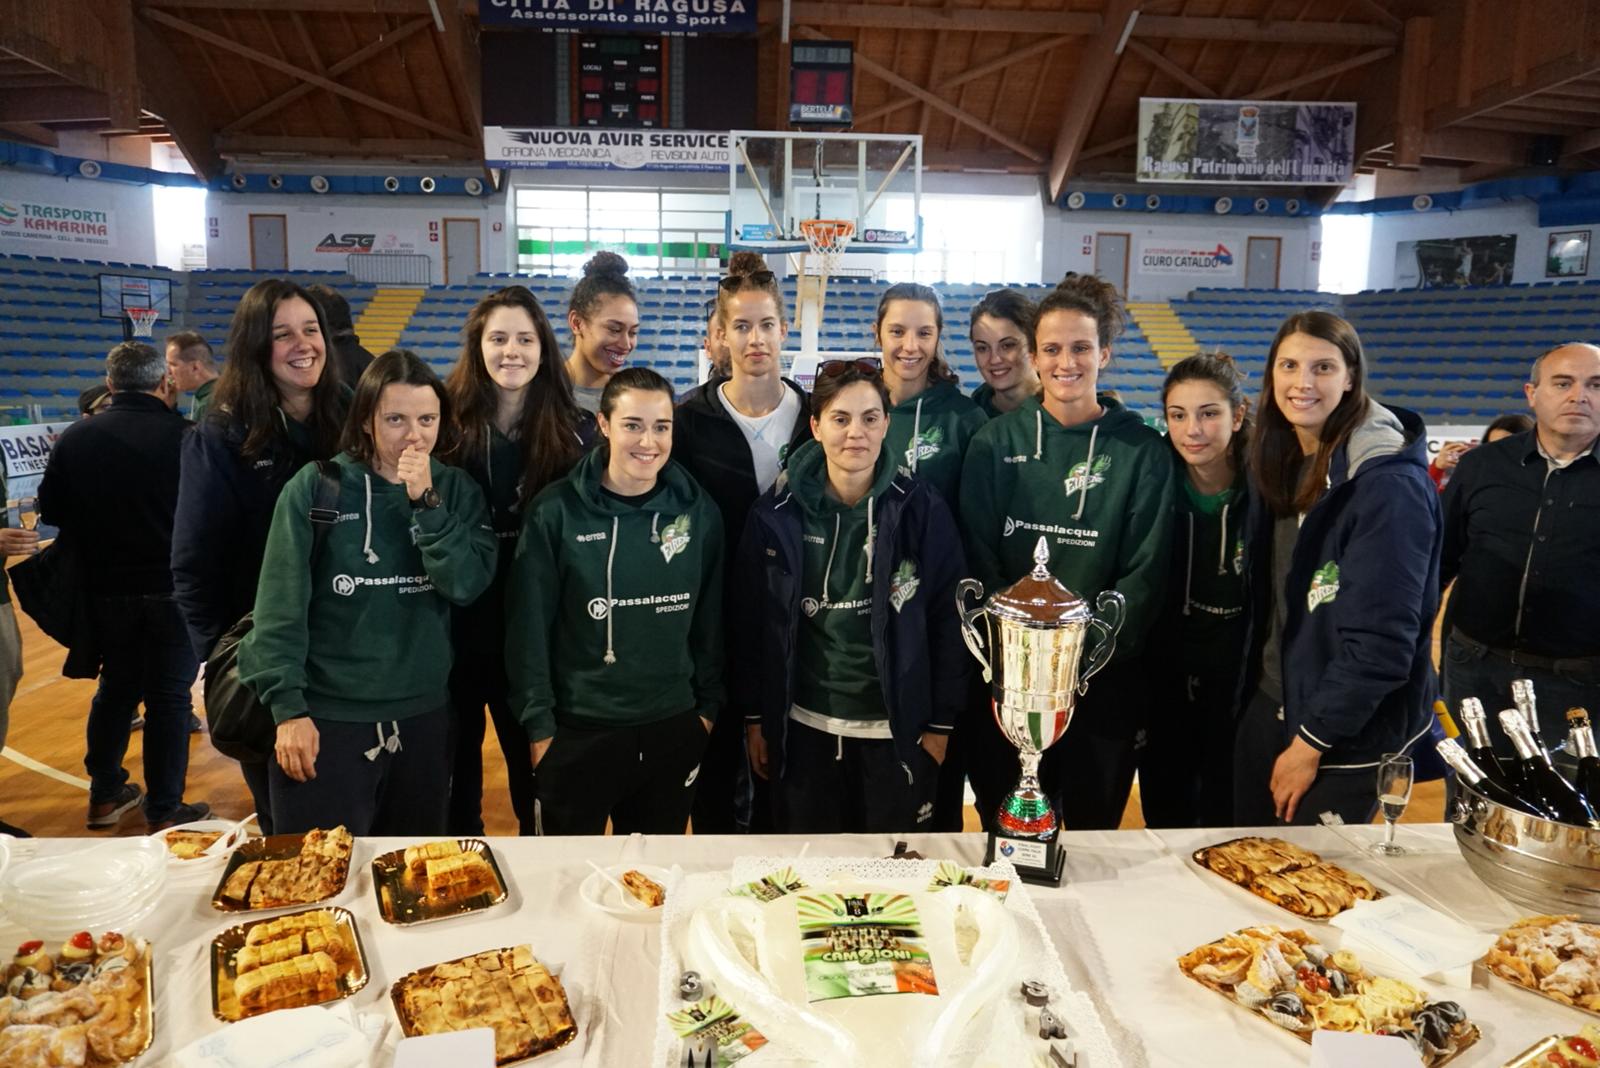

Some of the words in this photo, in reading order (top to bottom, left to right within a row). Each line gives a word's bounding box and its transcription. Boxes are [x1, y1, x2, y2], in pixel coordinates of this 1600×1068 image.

[634, 0, 746, 13] RAGUSA
[510, 8, 628, 22] Assessorato
[633, 13, 668, 24] allo
[676, 13, 727, 27] Sport
[526, 130, 593, 145] NUOVA
[598, 132, 644, 147] AVIR
[649, 133, 729, 148] SERVICE
[502, 146, 547, 157] OFFICINA
[549, 147, 612, 159] MECCANICA
[650, 149, 698, 161] REVISIONI
[700, 150, 730, 162] AUTO
[1143, 155, 1189, 176] Ragusa
[1192, 157, 1264, 176] Patrimonio
[21, 203, 107, 222] TRASPORTI
[24, 217, 107, 236] KAMARINA
[318, 232, 376, 248] ASG
[1143, 255, 1173, 266] CIURO
[1174, 256, 1219, 268] CATALDO
[1015, 519, 1099, 538] Passalacqua
[1057, 537, 1096, 548] SPEDIZIONI
[609, 592, 691, 608] Passalacqua
